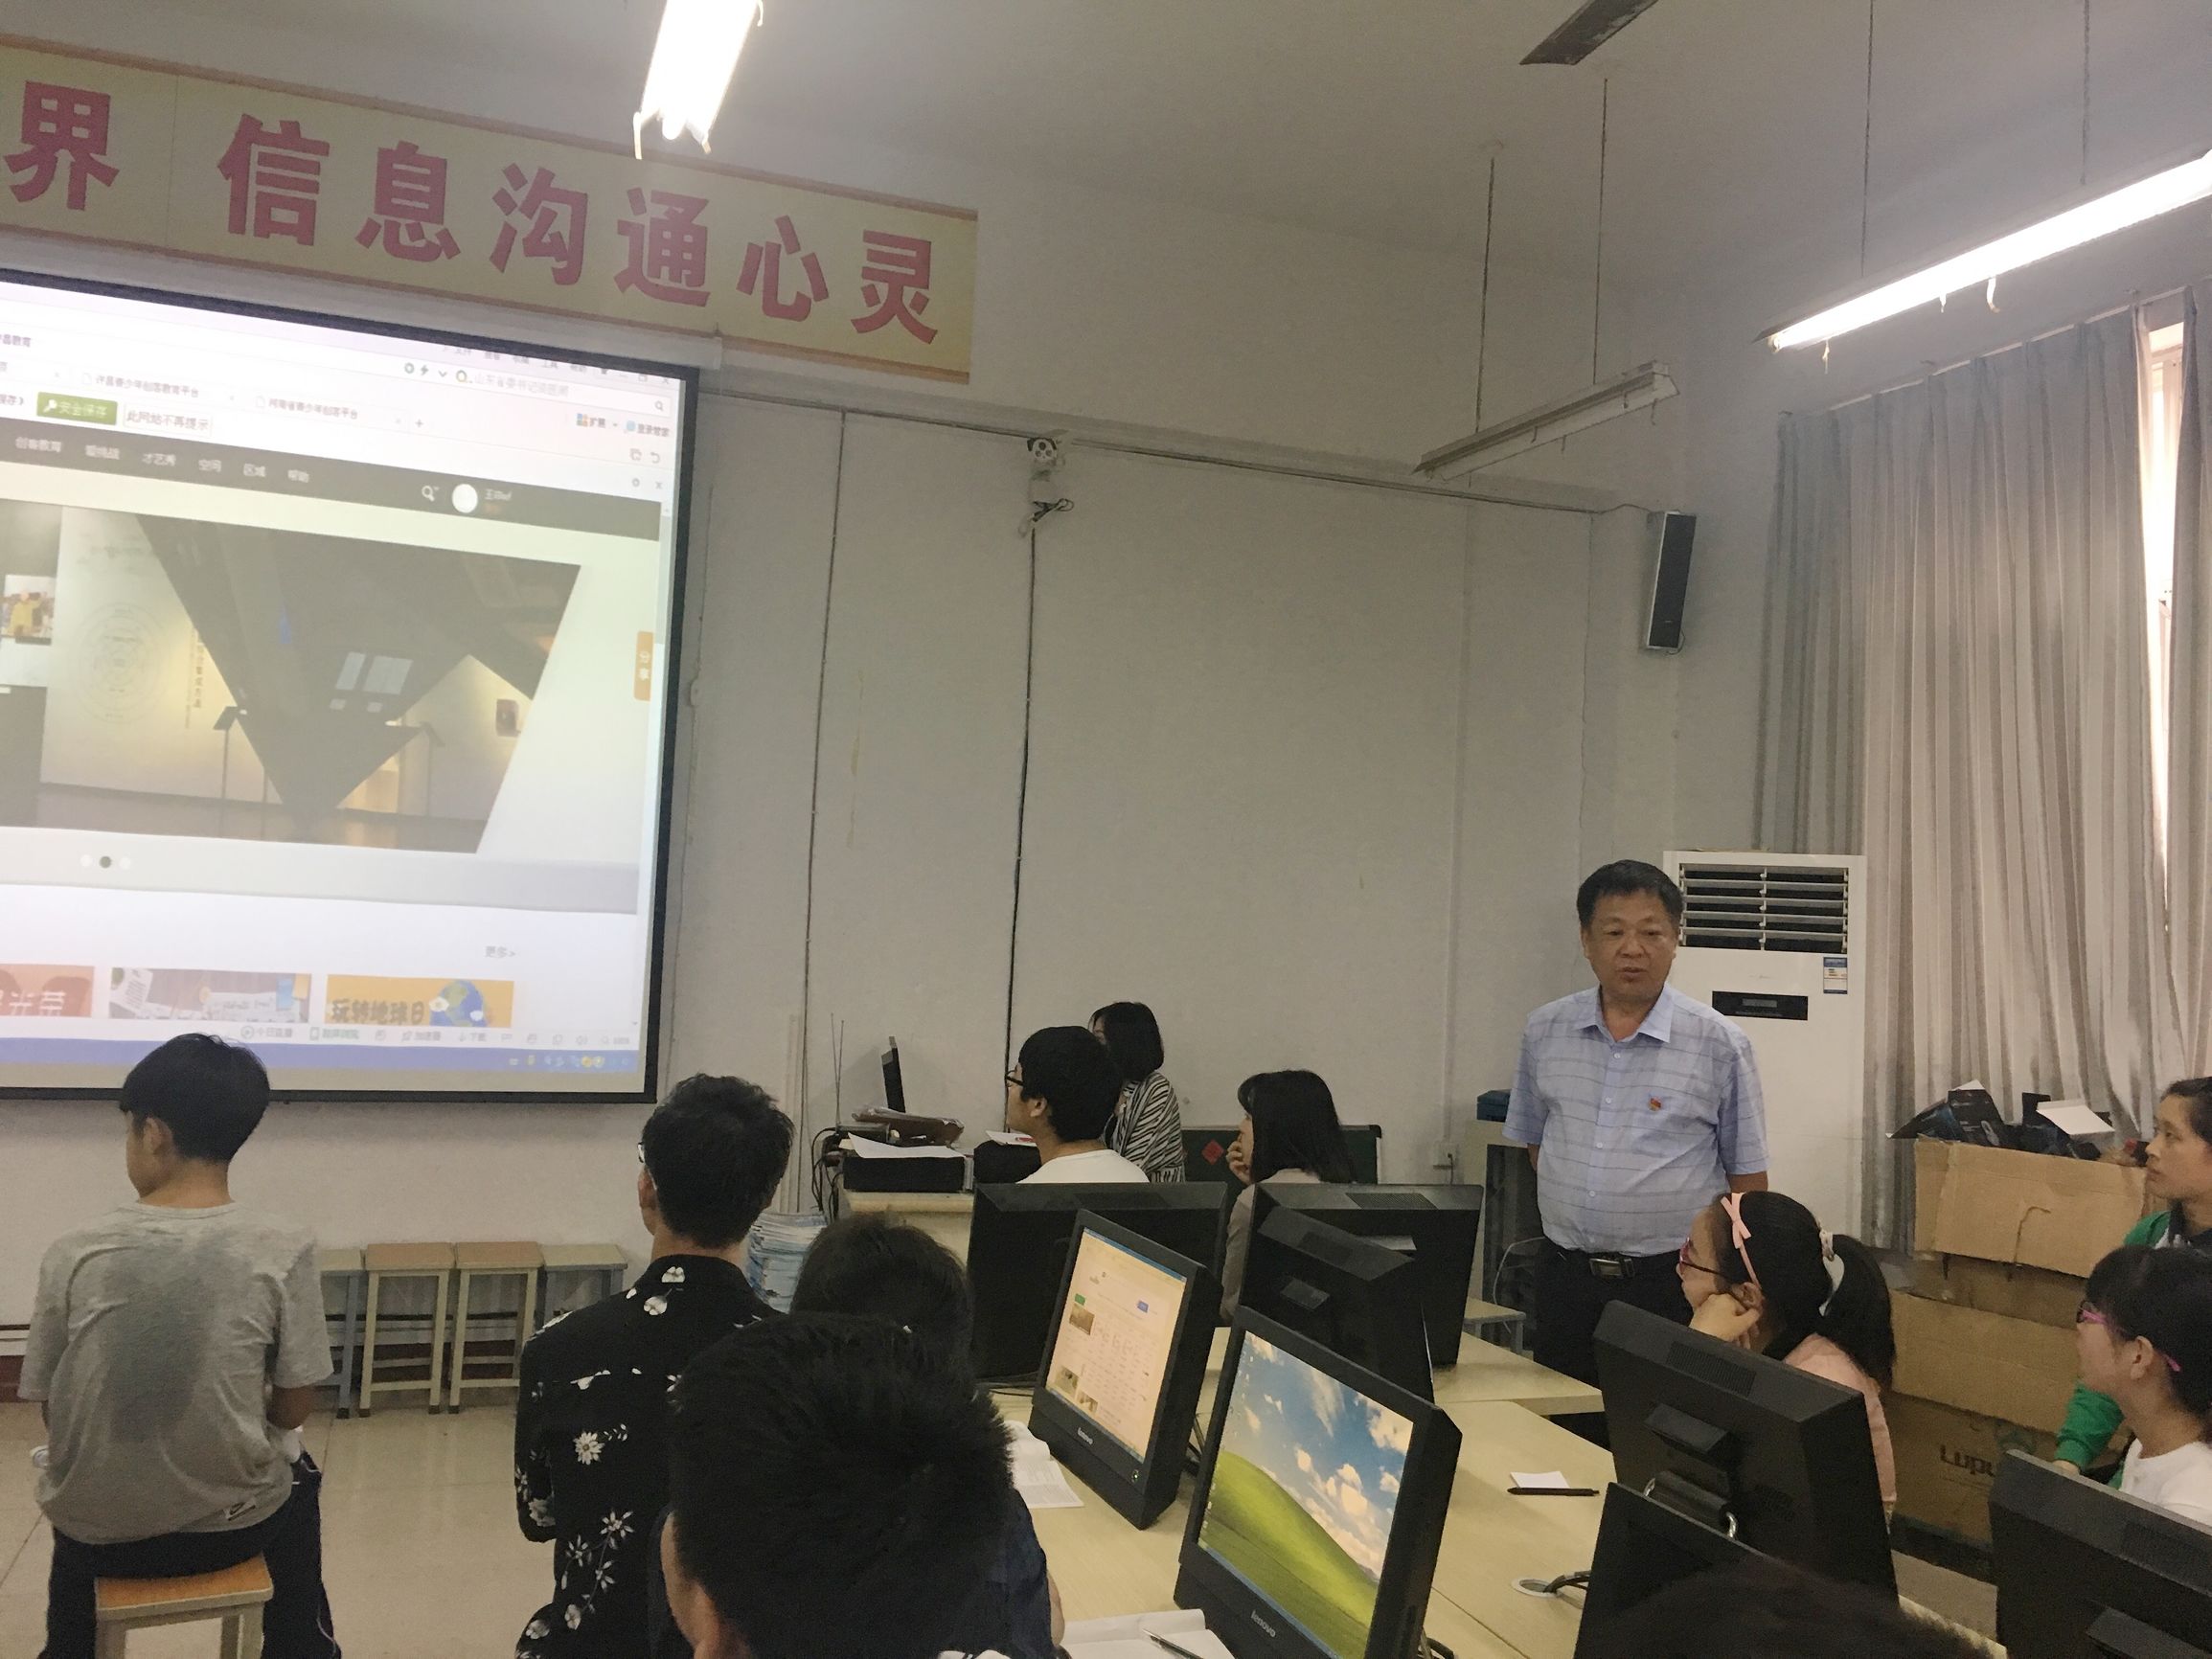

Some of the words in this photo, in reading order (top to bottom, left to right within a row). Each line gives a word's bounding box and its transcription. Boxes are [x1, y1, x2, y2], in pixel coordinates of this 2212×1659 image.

[3, 81, 120, 211] 界
[217, 113, 938, 345] 信息沟通心灵
[331, 998, 425, 1025] 玩转地球日
[1250, 1609, 1276, 1638] lenovo
